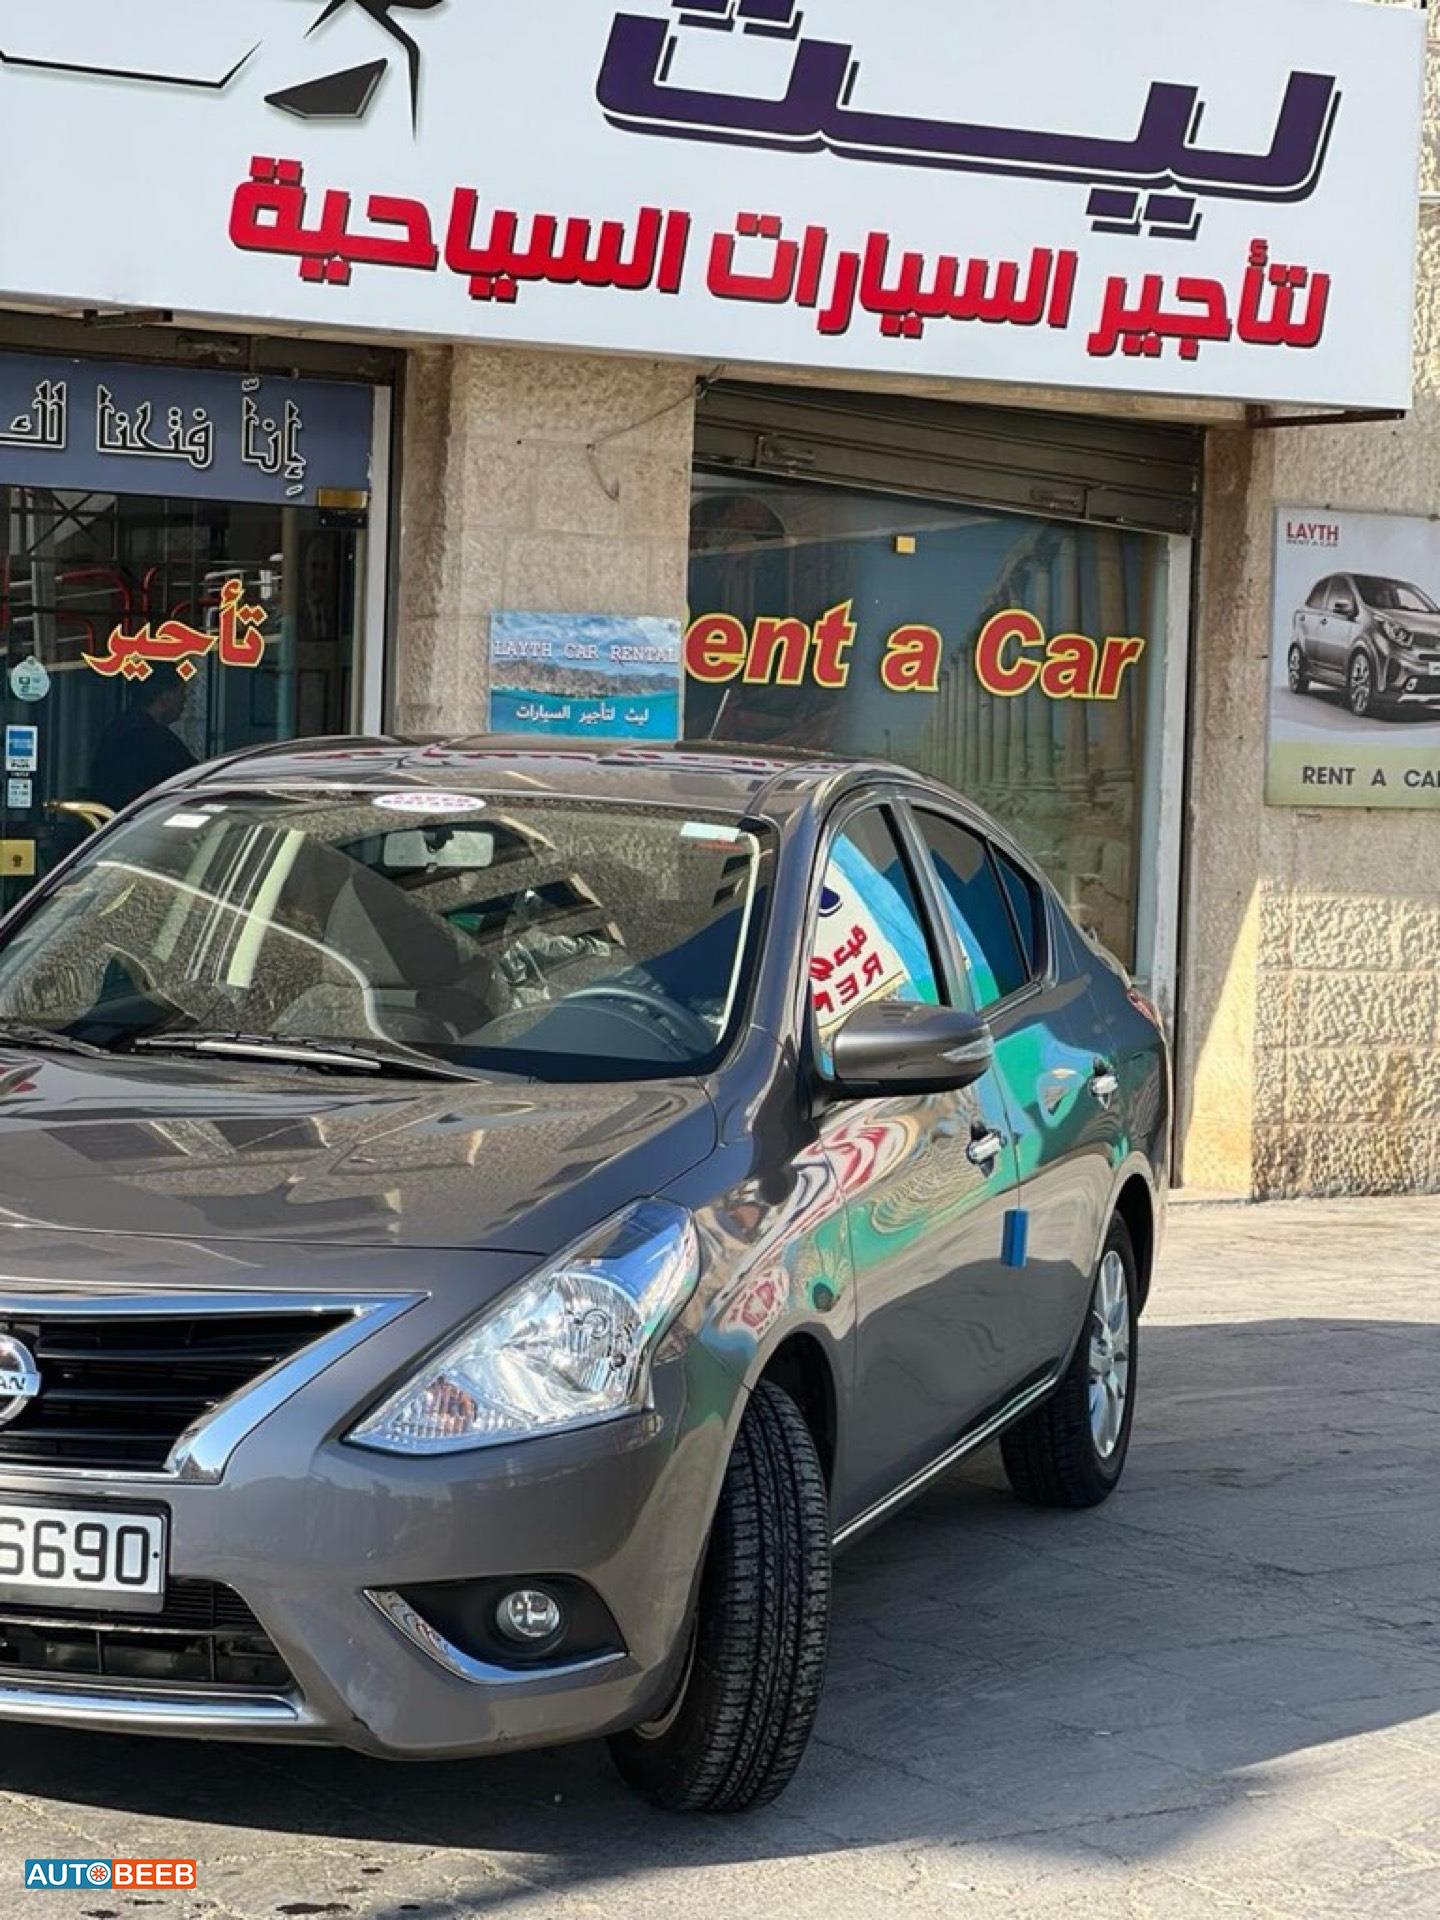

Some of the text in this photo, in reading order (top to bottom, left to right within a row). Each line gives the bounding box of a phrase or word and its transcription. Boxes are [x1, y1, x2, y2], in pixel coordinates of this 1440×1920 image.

[228, 155, 1330, 360] لتأجير السيارات السياحية
[1286, 521, 1340, 541] LAYTH
[82, 578, 269, 681] تأجير
[494, 641, 679, 664] LAYTH CAR RENTAL
[684, 598, 1145, 700] ent a Car
[515, 703, 571, 722] السيارات
[578, 701, 616, 724] لتأجير
[1302, 765, 1440, 788] RENT A CA
